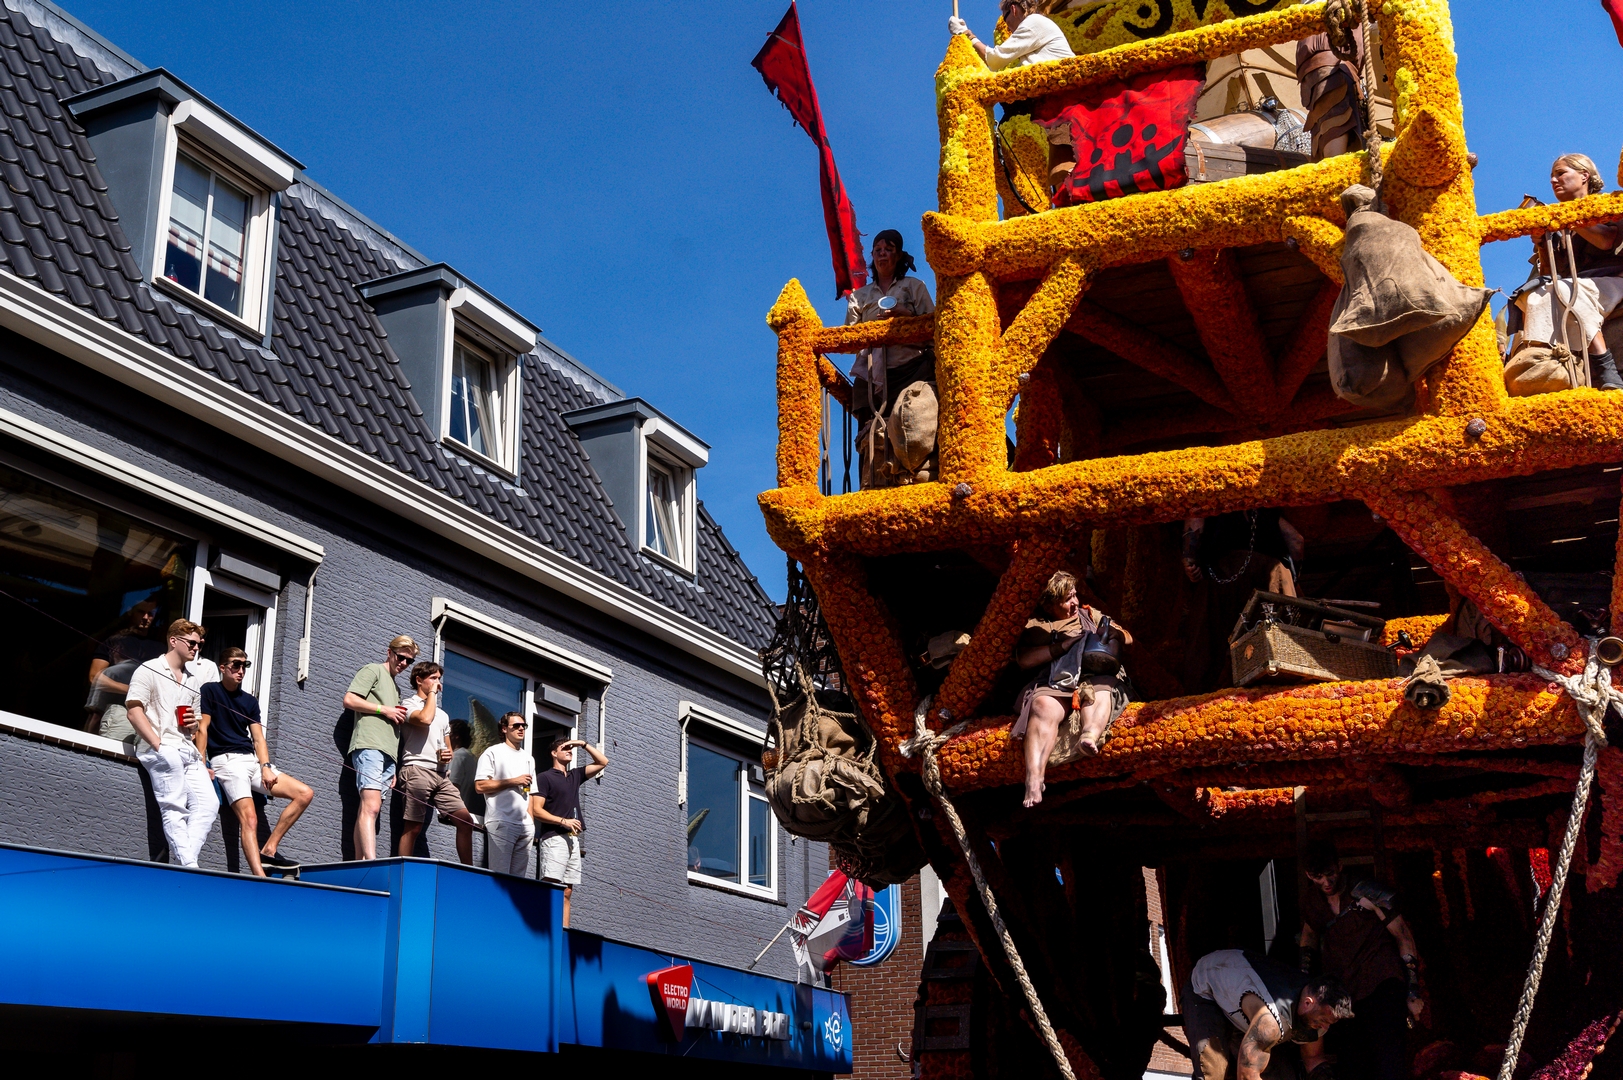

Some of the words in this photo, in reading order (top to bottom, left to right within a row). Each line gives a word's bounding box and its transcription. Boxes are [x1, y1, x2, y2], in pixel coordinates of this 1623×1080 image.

[664, 983, 688, 997] ELECTRO
[666, 997, 686, 1010] WORLD
[724, 1004, 757, 1035] DER
